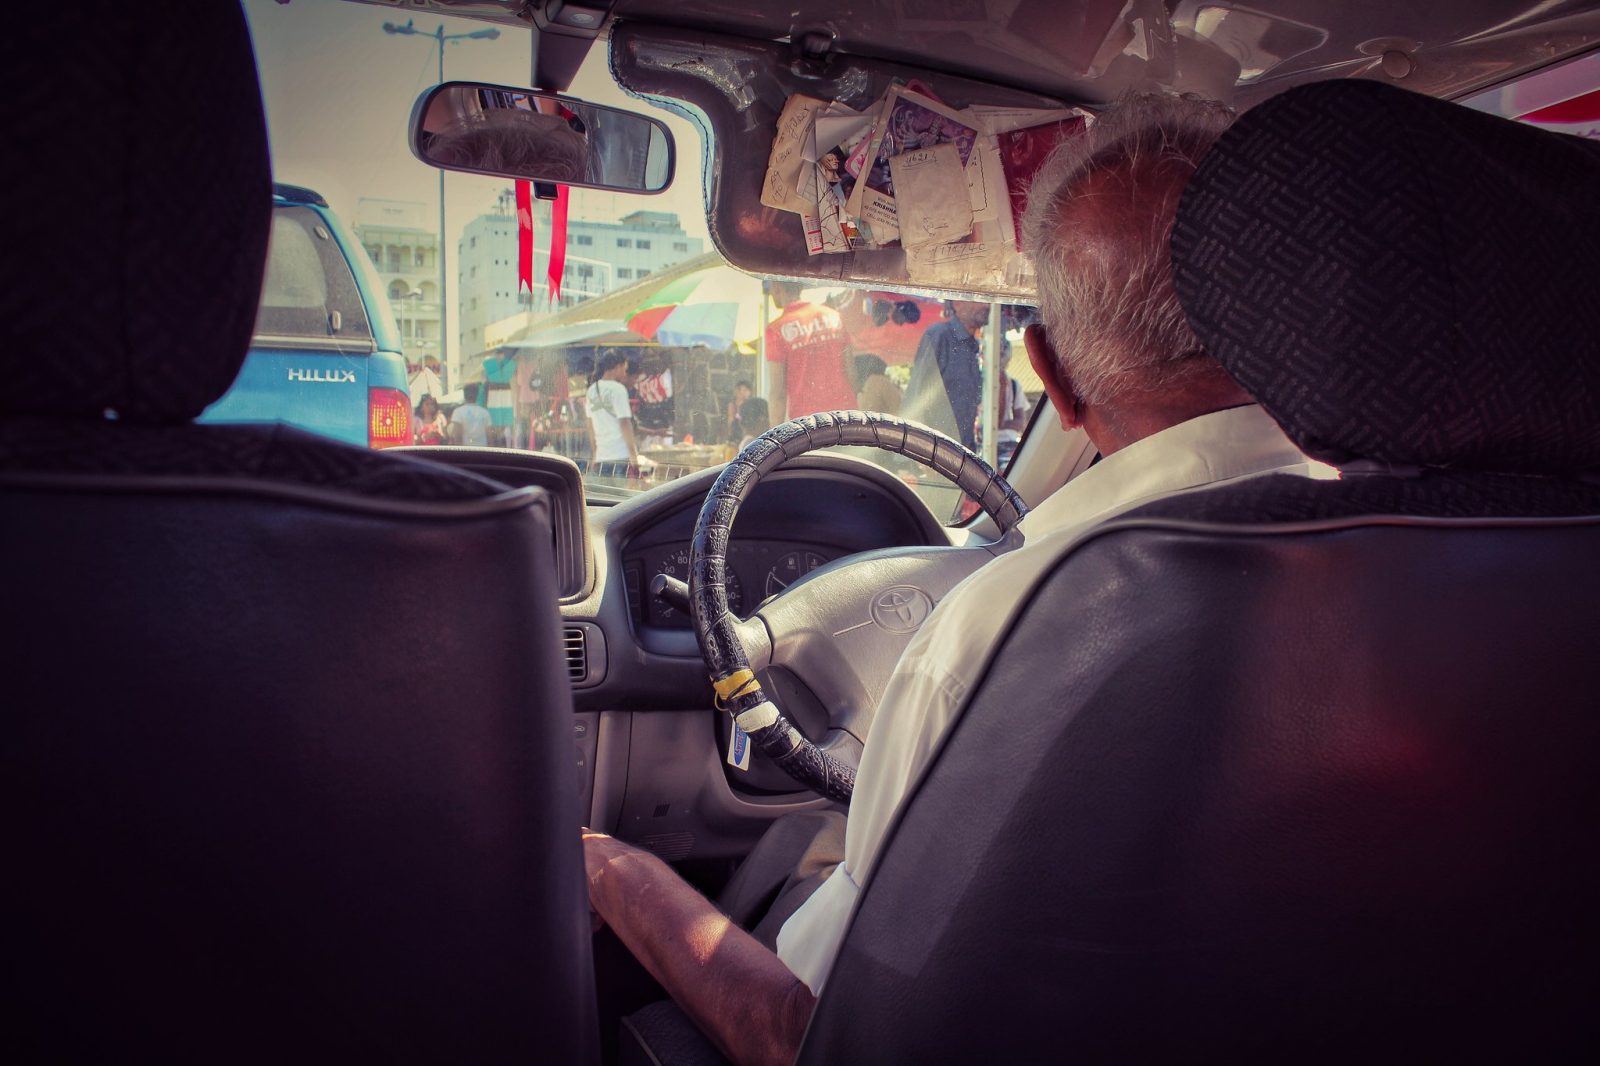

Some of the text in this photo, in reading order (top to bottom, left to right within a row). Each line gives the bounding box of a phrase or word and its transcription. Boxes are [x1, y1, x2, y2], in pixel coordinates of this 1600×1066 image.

[288, 368, 356, 383] HILUX
[677, 556, 688, 565] 80
[664, 565, 676, 574] 60
